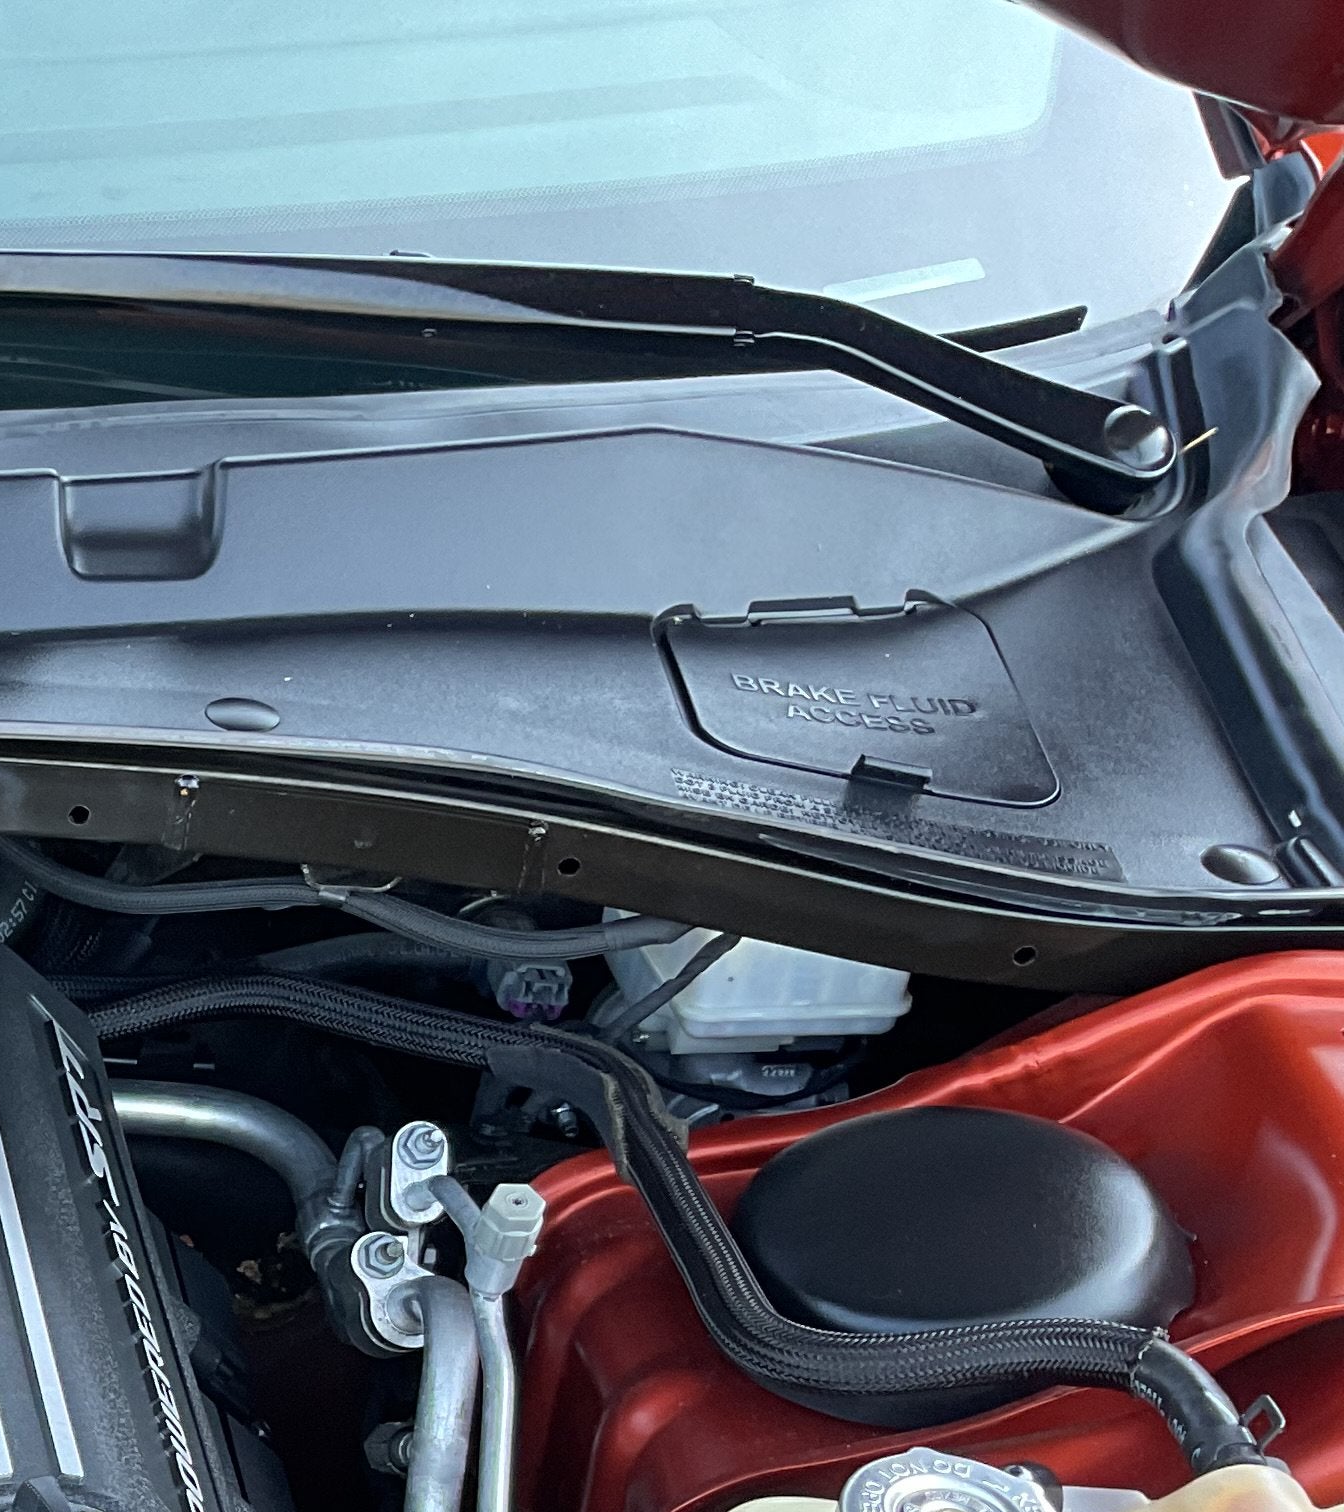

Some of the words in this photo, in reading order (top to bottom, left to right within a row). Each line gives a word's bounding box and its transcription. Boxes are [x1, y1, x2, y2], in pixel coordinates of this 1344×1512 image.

[731, 670, 859, 709] BRAKE
[870, 693, 980, 718] FLUID
[786, 703, 937, 737] ACCESS
[51, 1019, 120, 1207] SRT
[879, 1461, 929, 1484] NOT
[932, 1458, 975, 1479] DO
